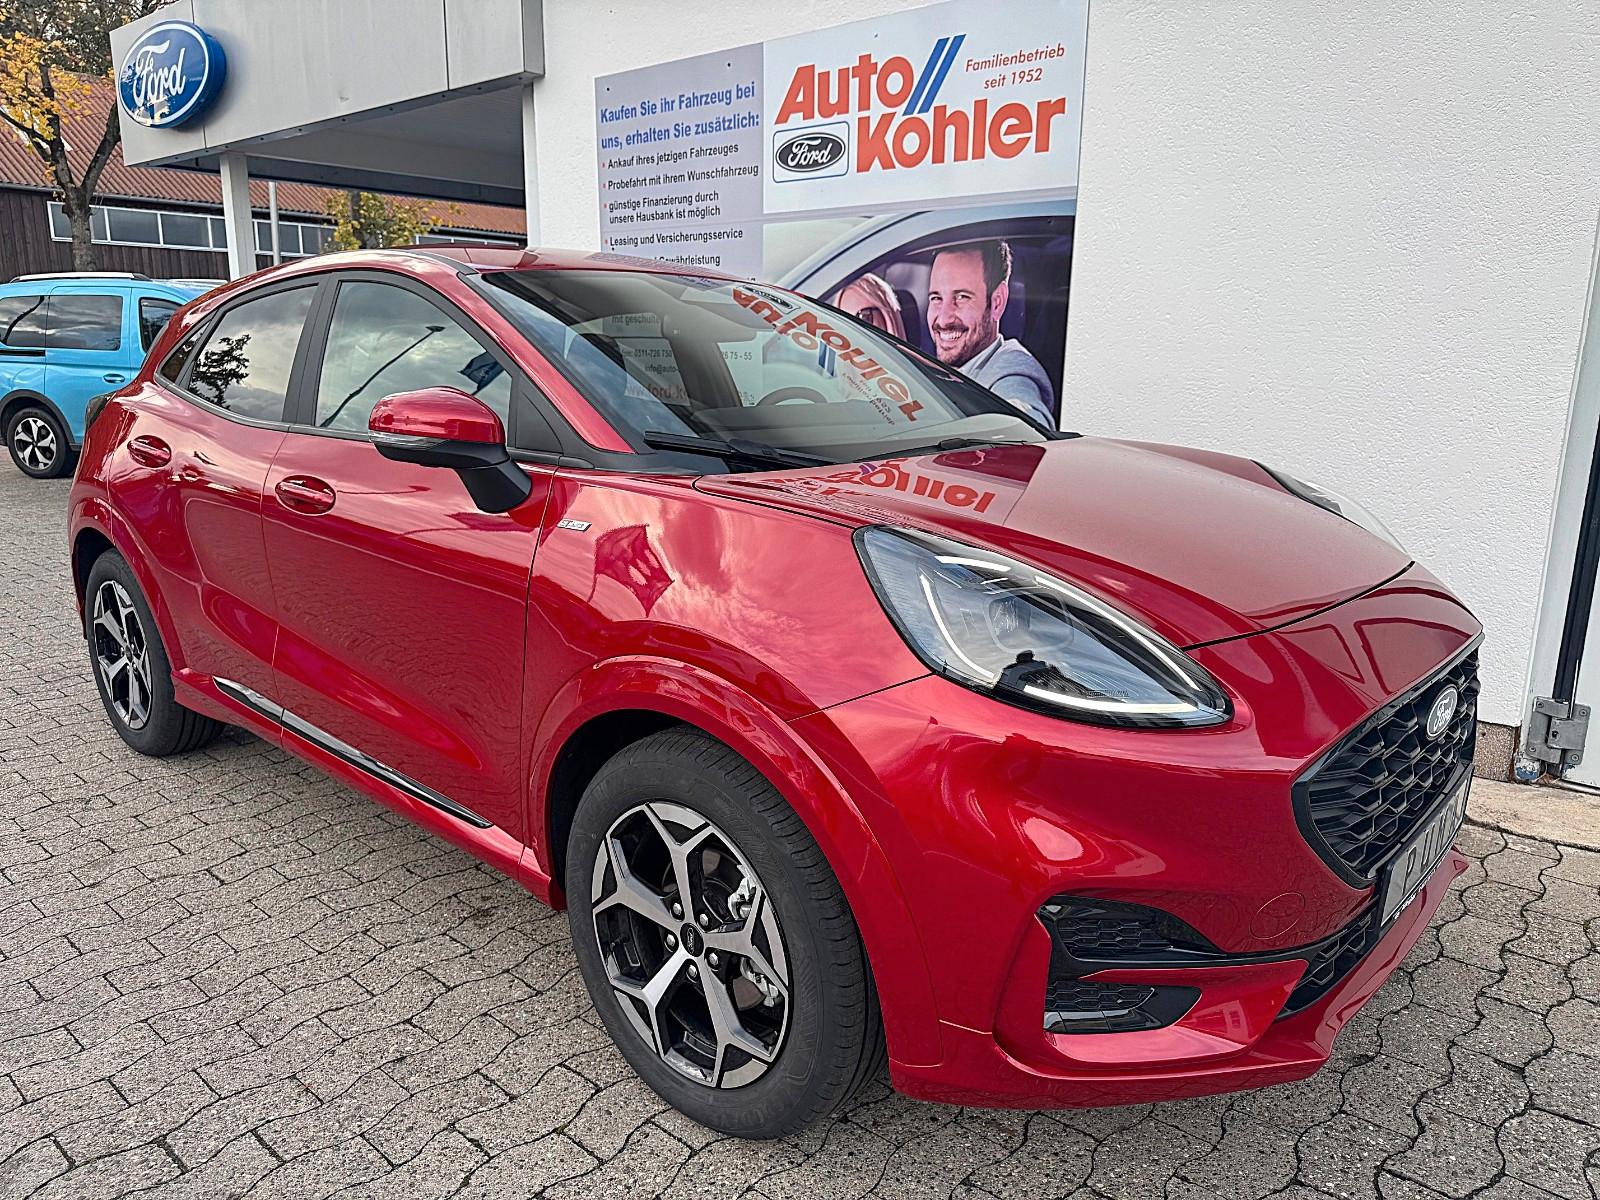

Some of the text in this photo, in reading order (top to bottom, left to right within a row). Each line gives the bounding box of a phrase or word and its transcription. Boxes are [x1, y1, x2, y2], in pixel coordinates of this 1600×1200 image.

[965, 44, 1065, 73] Familienbetrieb
[133, 40, 186, 107] Ford
[983, 68, 1043, 90] seit 1952
[600, 81, 755, 123] Kaufen Sie ihr Fahrzeug bei
[774, 53, 915, 125] Auto
[601, 111, 760, 150] uns, erhalten Sie zusätzlich:
[607, 143, 739, 169] Ankauf ihres jetzigen Fahrzeuges
[787, 137, 832, 168] Ford
[608, 164, 759, 191] Probefahrt mit ihrem Wunschfahrzeug
[609, 190, 719, 213] günstige Finanzierung durch
[609, 205, 721, 224] unsere Hausbank ist möglich
[610, 228, 743, 248] Leasing und Versicherungsservice
[1433, 696, 1454, 733] Ford
